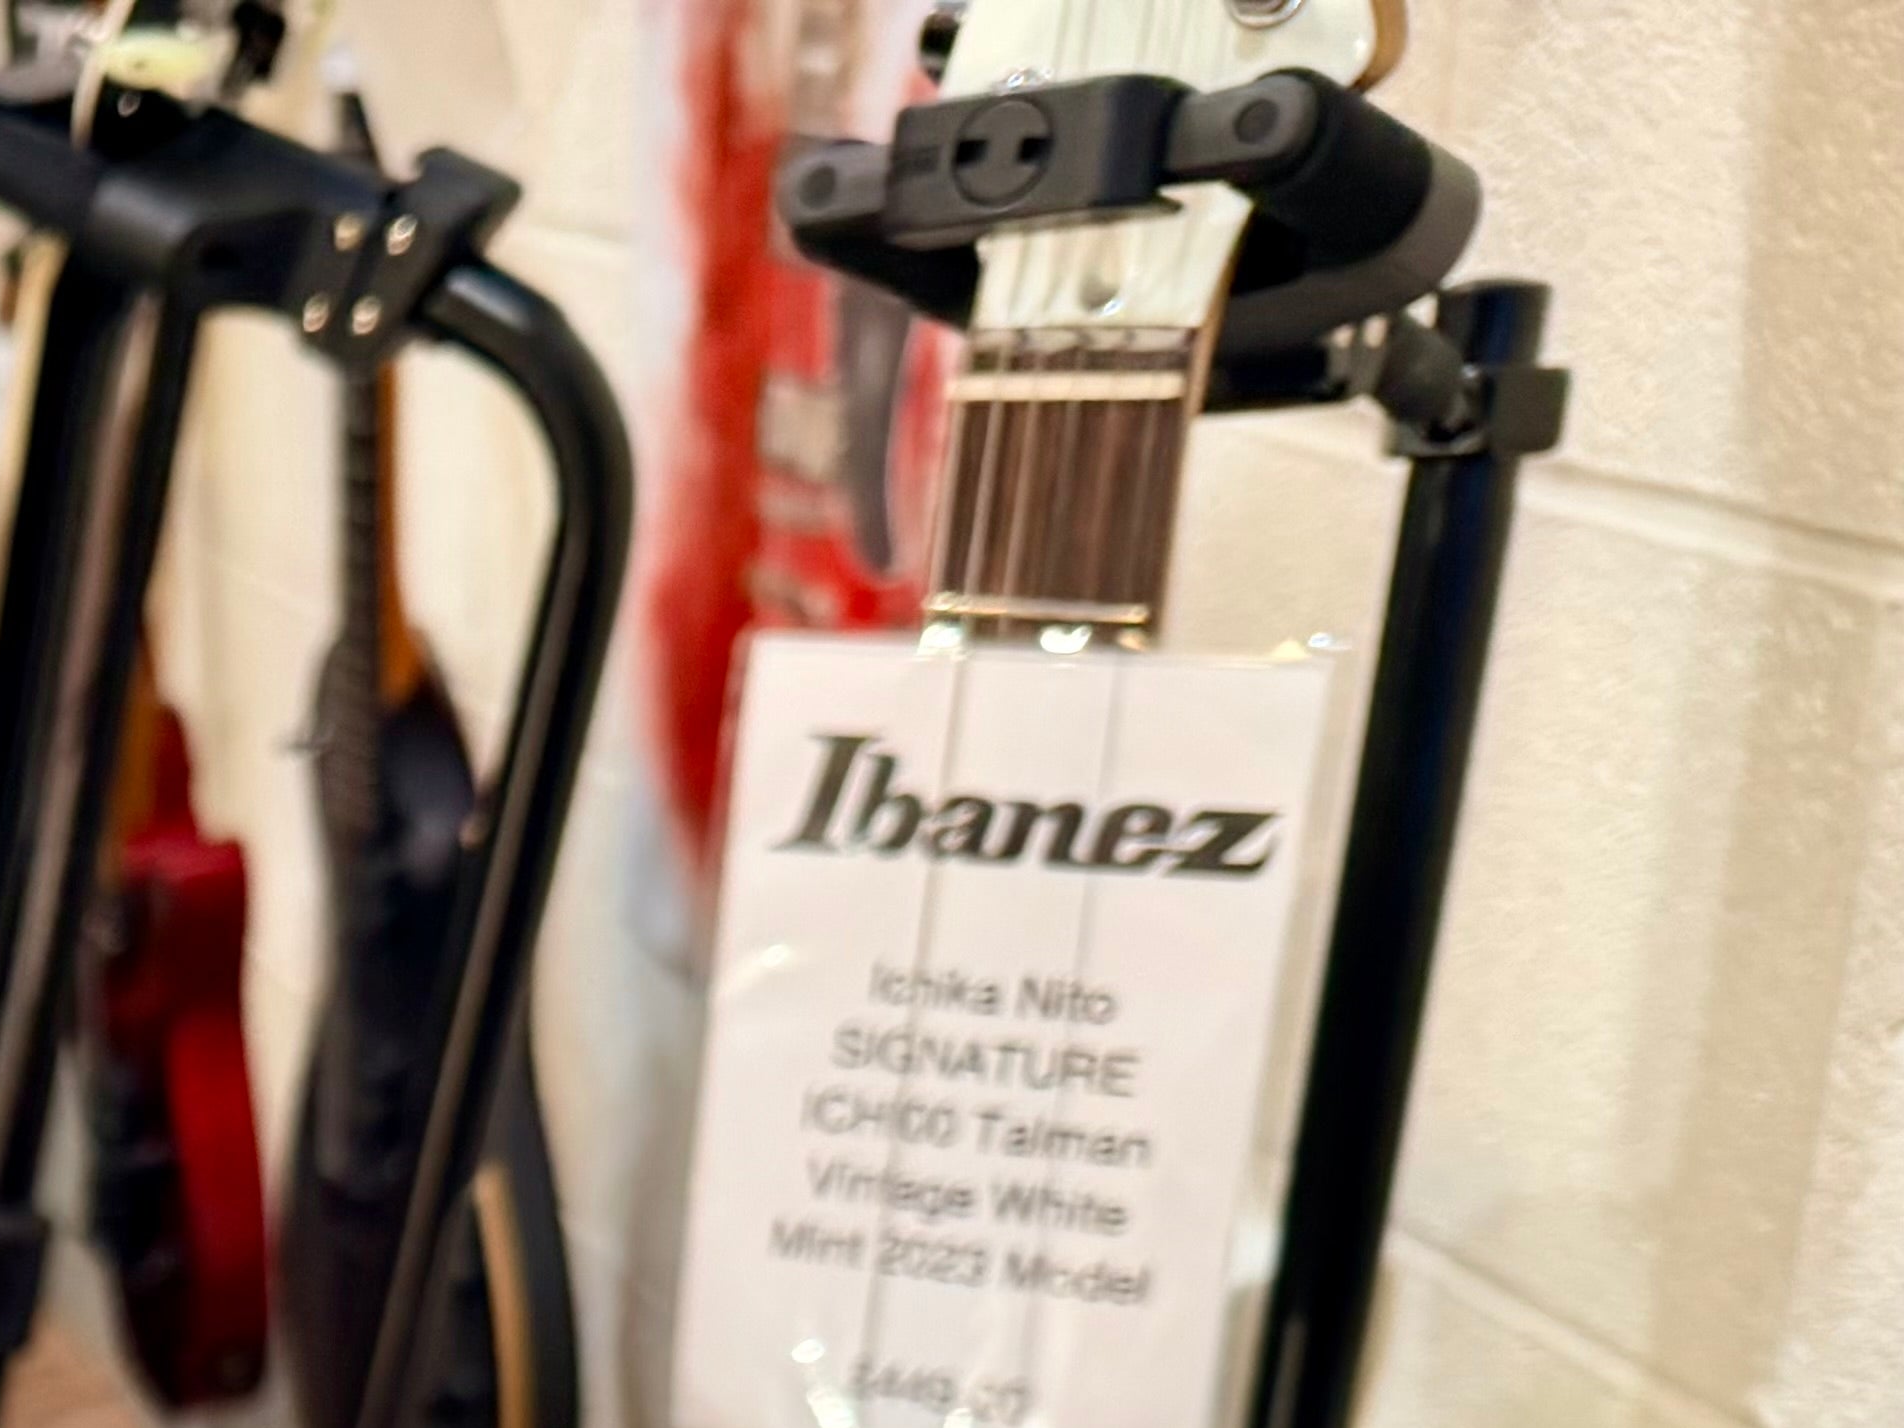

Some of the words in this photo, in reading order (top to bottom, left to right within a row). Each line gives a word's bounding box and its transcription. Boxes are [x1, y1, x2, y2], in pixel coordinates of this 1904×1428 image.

[771, 732, 1286, 880] Ibanez
[1015, 973, 1119, 1024] Nito
[830, 1017, 1140, 1097] SIGNATURE
[975, 1106, 1151, 1168] Talman
[807, 1151, 975, 1226] Vintage
[991, 1182, 1128, 1235] White
[768, 1214, 865, 1268] Mint
[1001, 1249, 1152, 1304] Model
